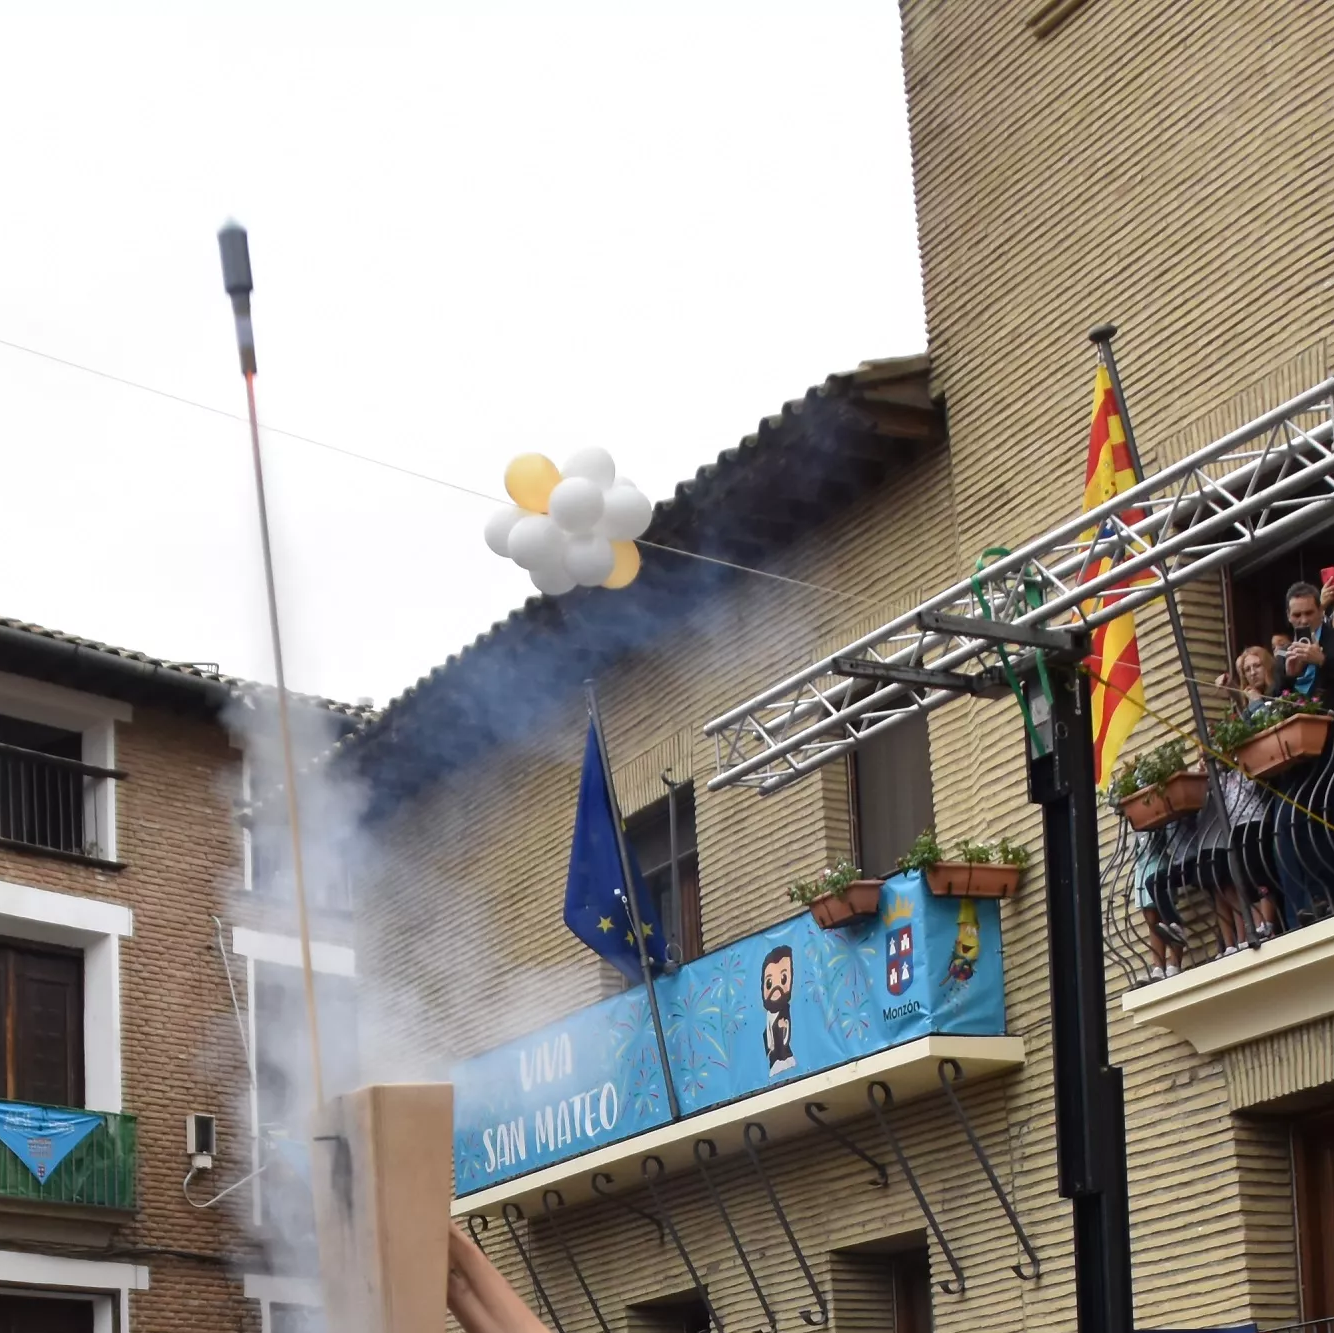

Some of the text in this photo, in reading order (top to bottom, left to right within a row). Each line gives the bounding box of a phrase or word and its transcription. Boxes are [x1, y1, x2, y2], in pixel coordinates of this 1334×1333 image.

[883, 999, 920, 1022] Monzón
[520, 1032, 572, 1092] VIVA
[482, 1081, 618, 1173] SAN MATEO
